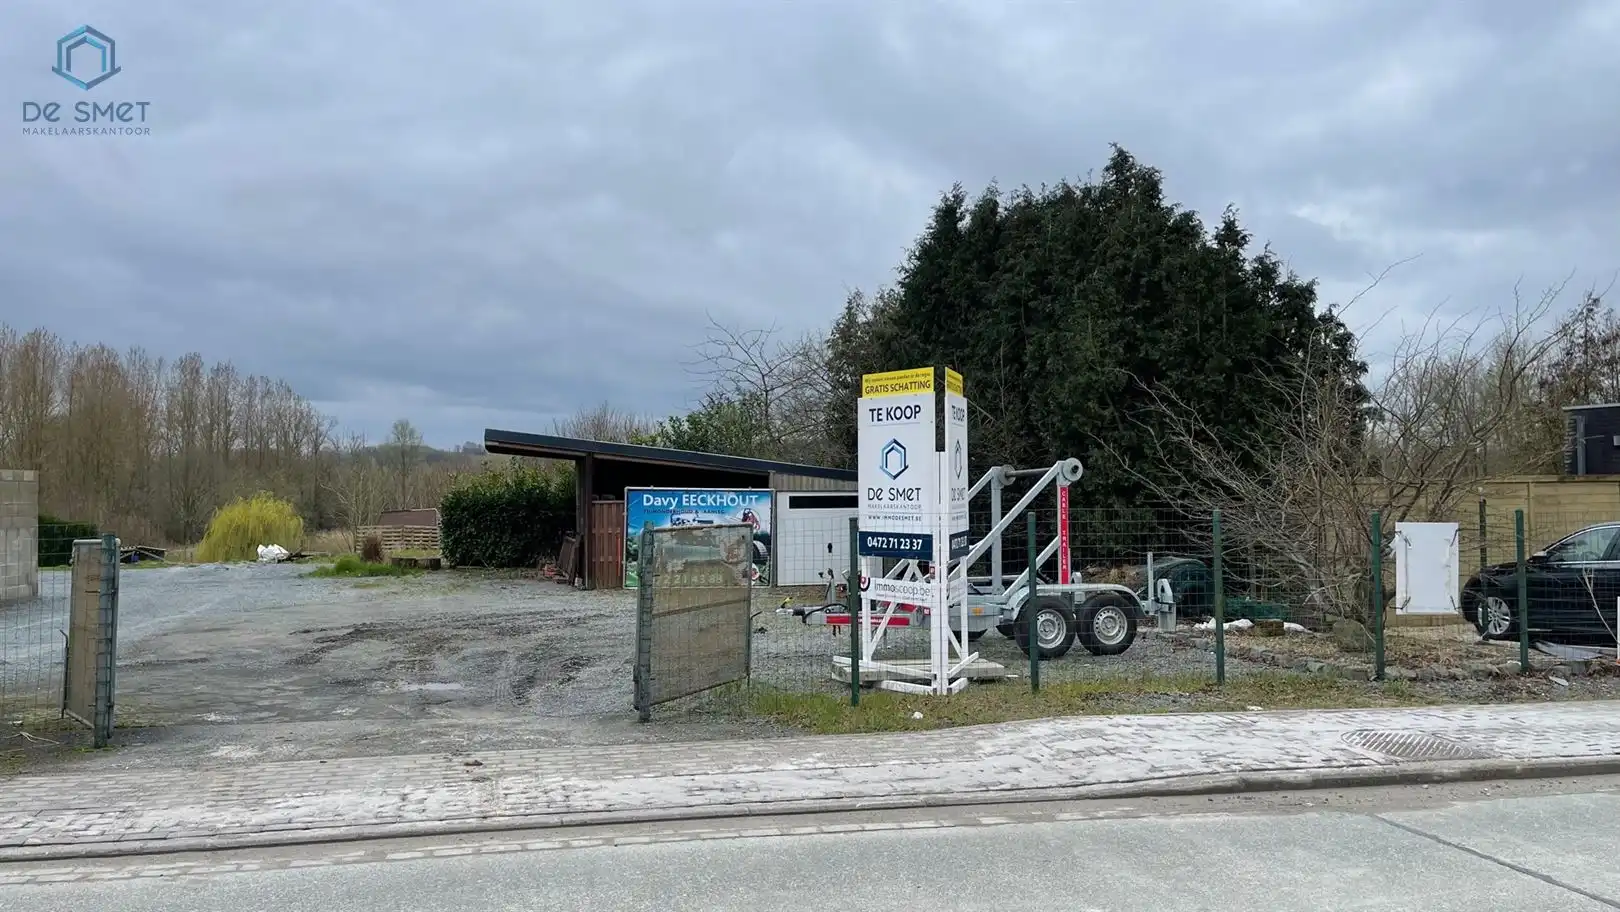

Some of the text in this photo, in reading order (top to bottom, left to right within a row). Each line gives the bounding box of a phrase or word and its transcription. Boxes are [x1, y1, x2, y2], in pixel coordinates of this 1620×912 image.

[865, 380, 931, 395] GRATIS SCHATTING
[869, 405, 921, 422] TE KOOP
[643, 494, 759, 509] Davy EECKHOUT
[867, 536, 923, 550] 0472 71 23 37
